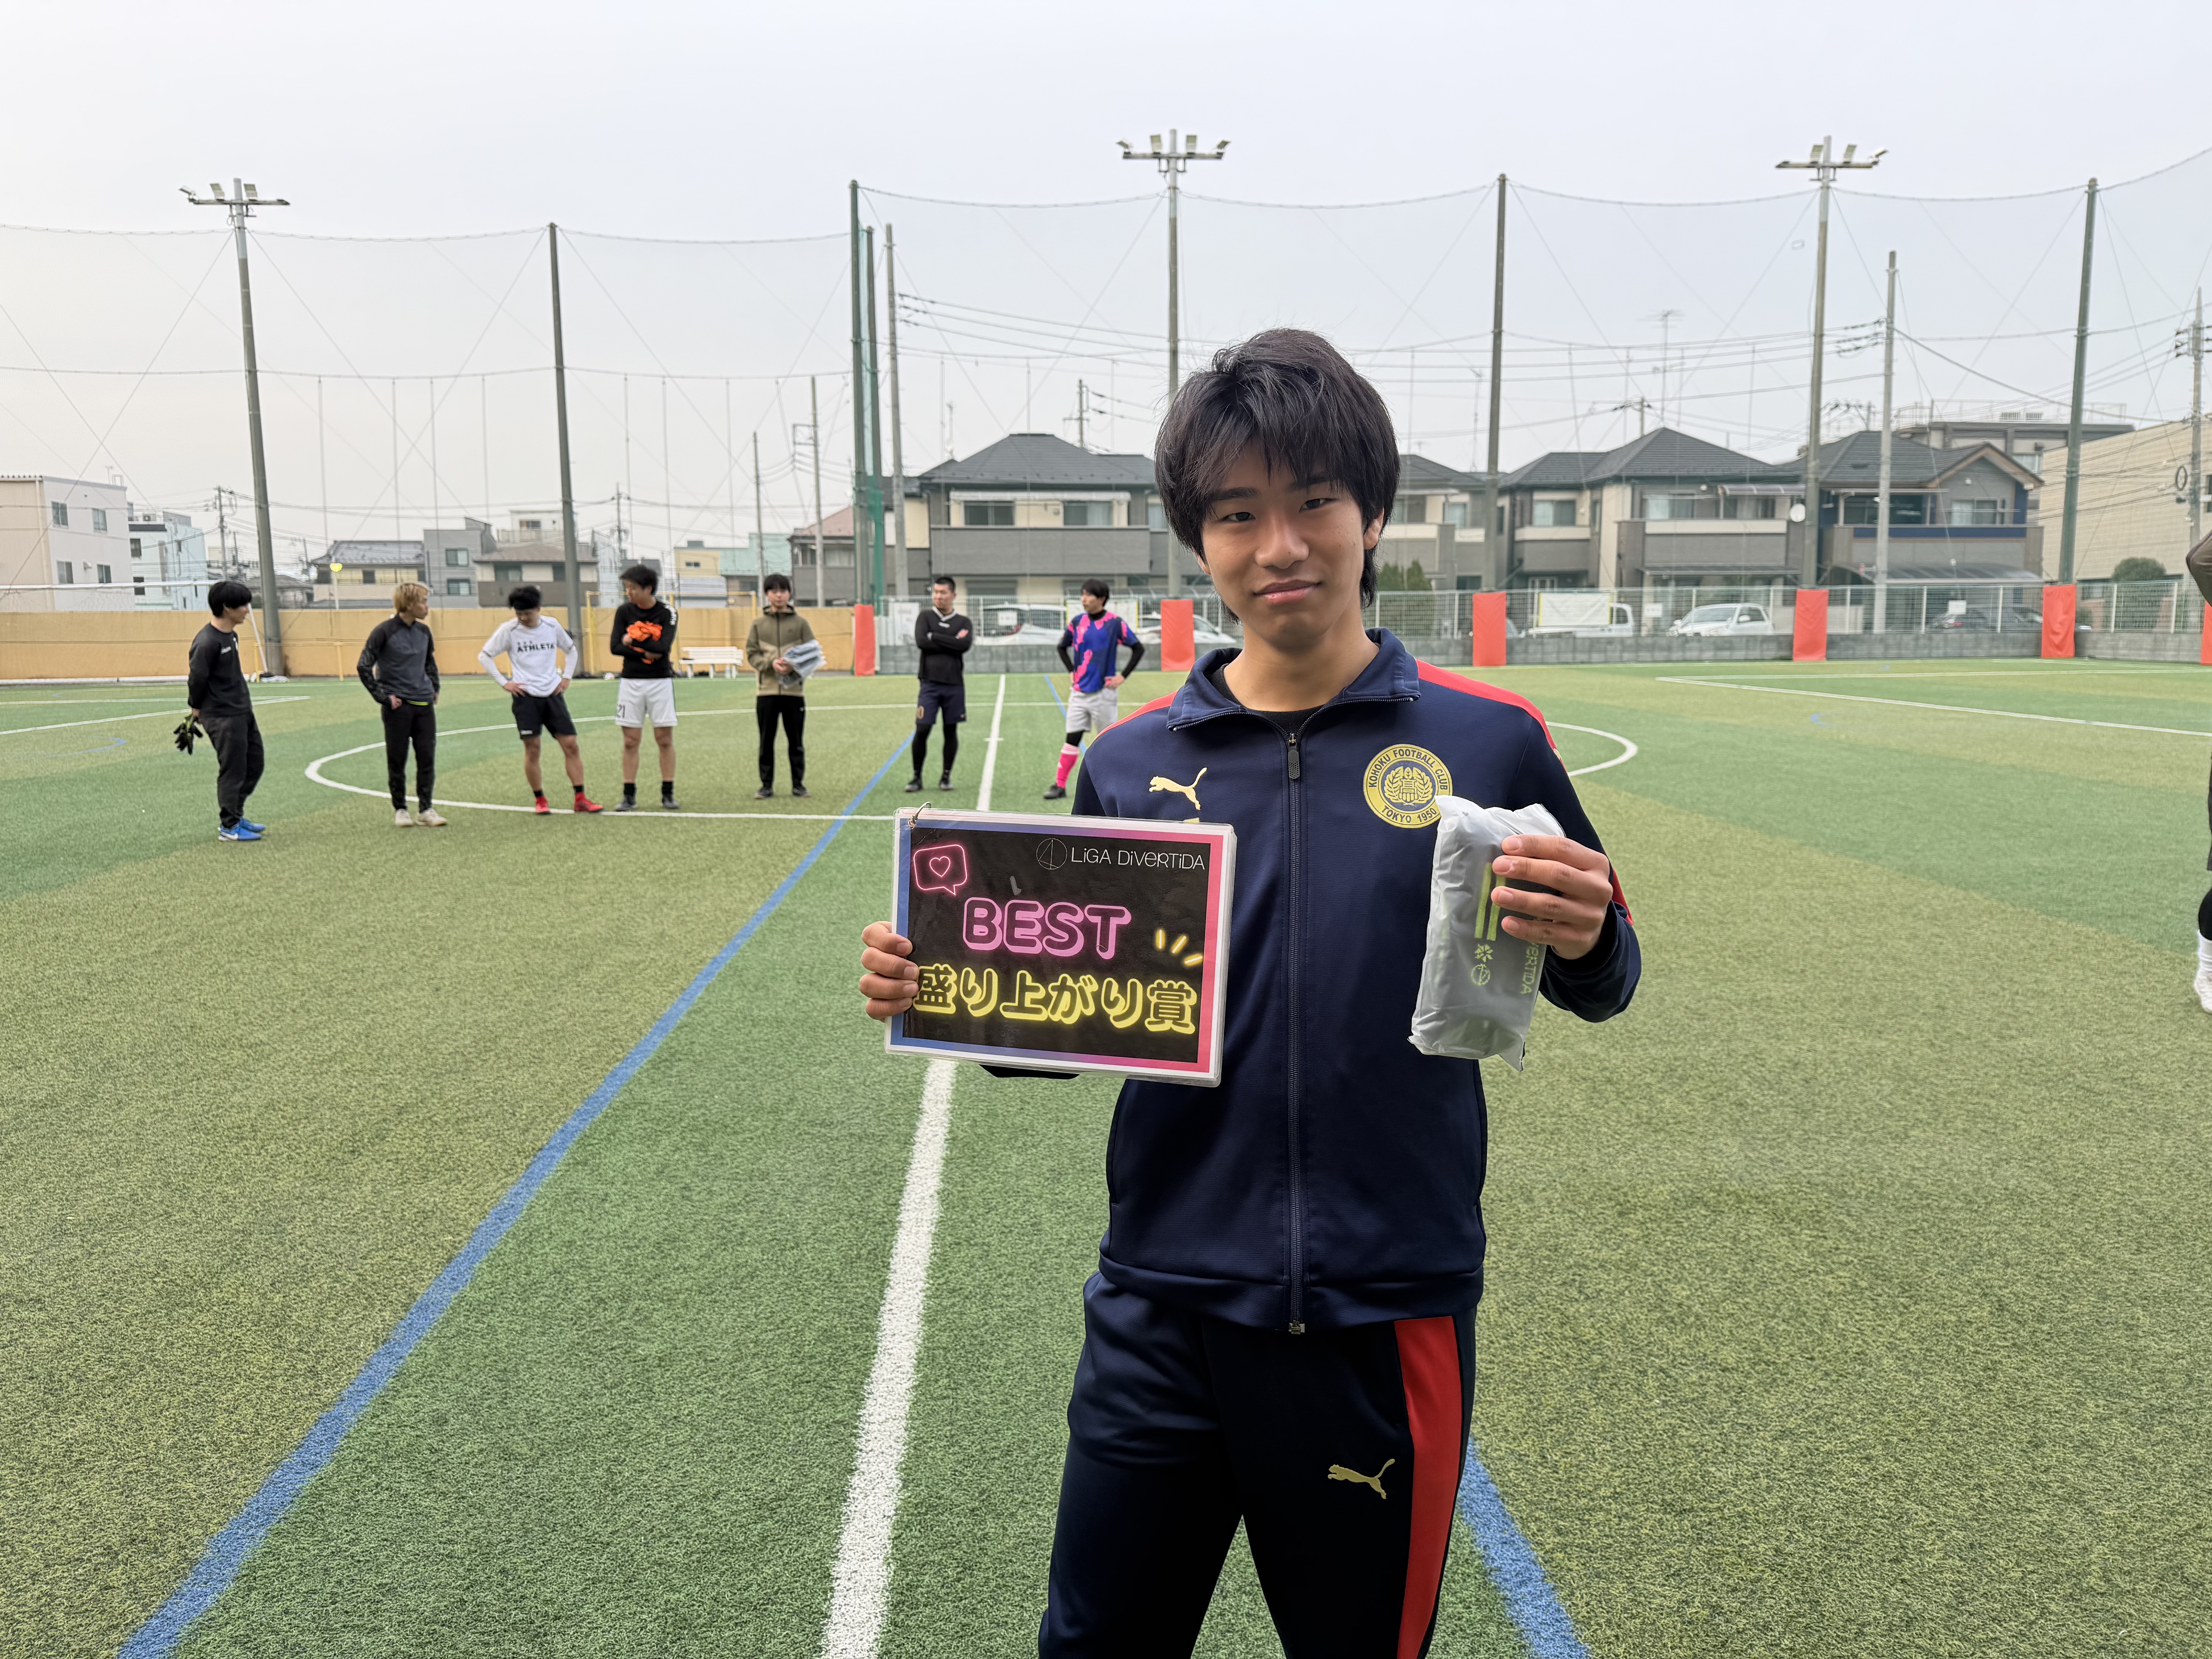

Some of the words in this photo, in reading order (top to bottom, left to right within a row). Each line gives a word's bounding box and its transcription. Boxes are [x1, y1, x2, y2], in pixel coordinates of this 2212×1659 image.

[1369, 754, 1391, 788] KOHOKU
[1393, 749, 1436, 768] FOOTBALL
[1435, 769, 1448, 790] CLUB
[1381, 805, 1412, 823] TOKYO
[1417, 807, 1437, 823] 1950
[962, 897, 1132, 960] BEST
[913, 962, 1198, 1035] 盛り上がり賞
